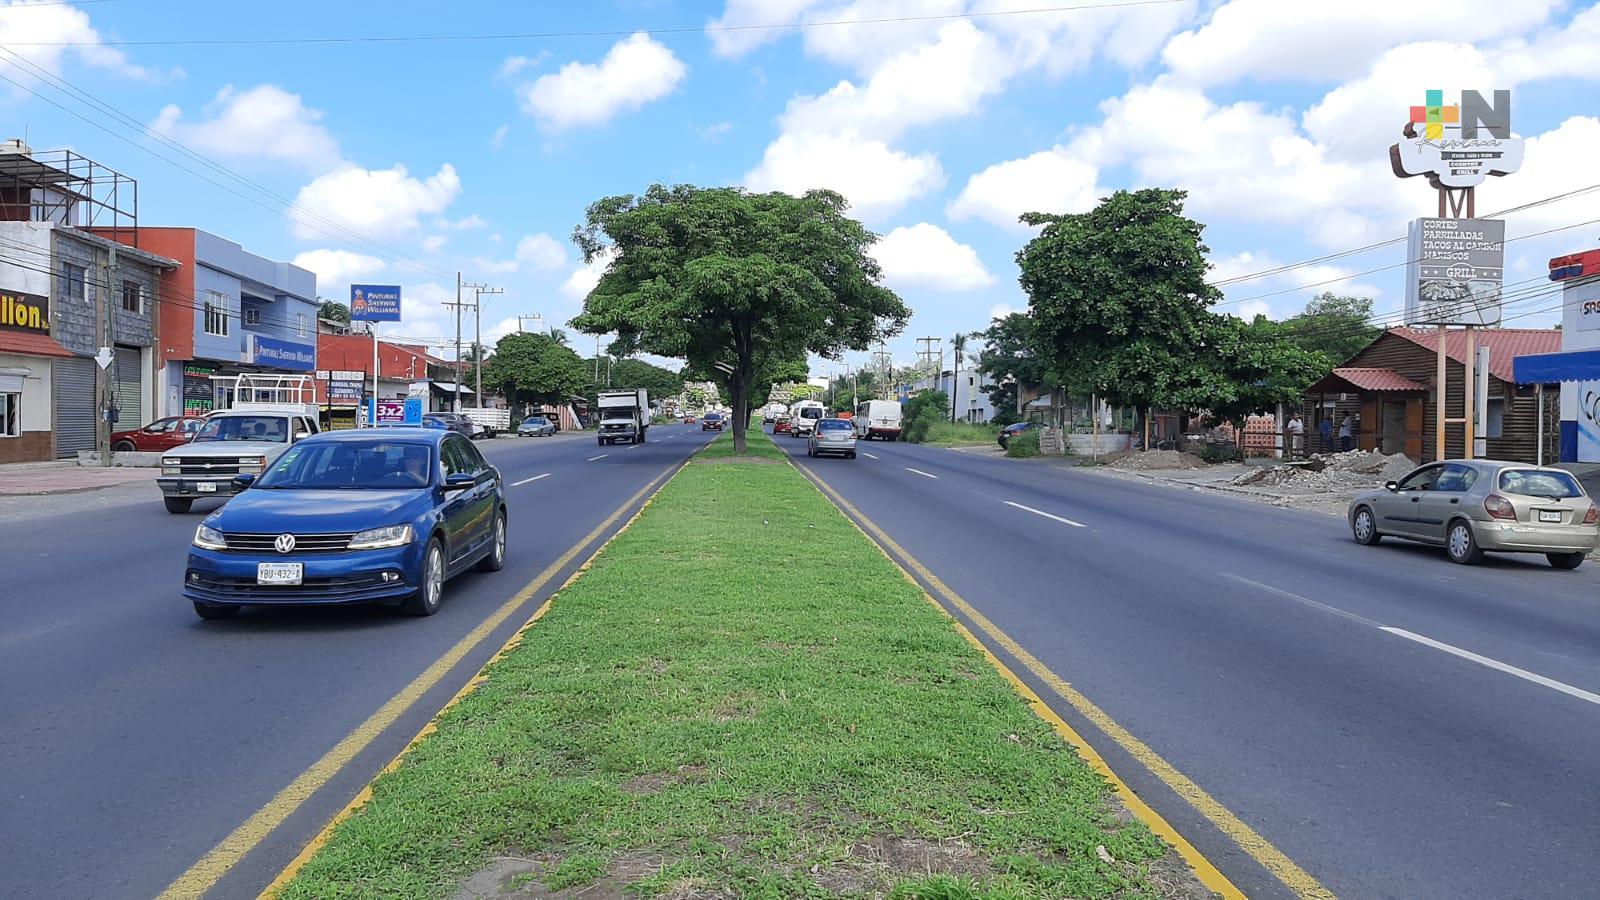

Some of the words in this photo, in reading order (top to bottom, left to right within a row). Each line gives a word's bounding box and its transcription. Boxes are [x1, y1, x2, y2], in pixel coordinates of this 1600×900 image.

[1423, 220, 1458, 230] CORTES
[1423, 230, 1484, 240] PARRILLADAS
[1423, 241, 1452, 250] TACOS
[1453, 241, 1465, 250] AL
[1446, 267, 1478, 278] GRILL
[367, 292, 398, 300] PINTURAS
[377, 405, 404, 417] 3x2
